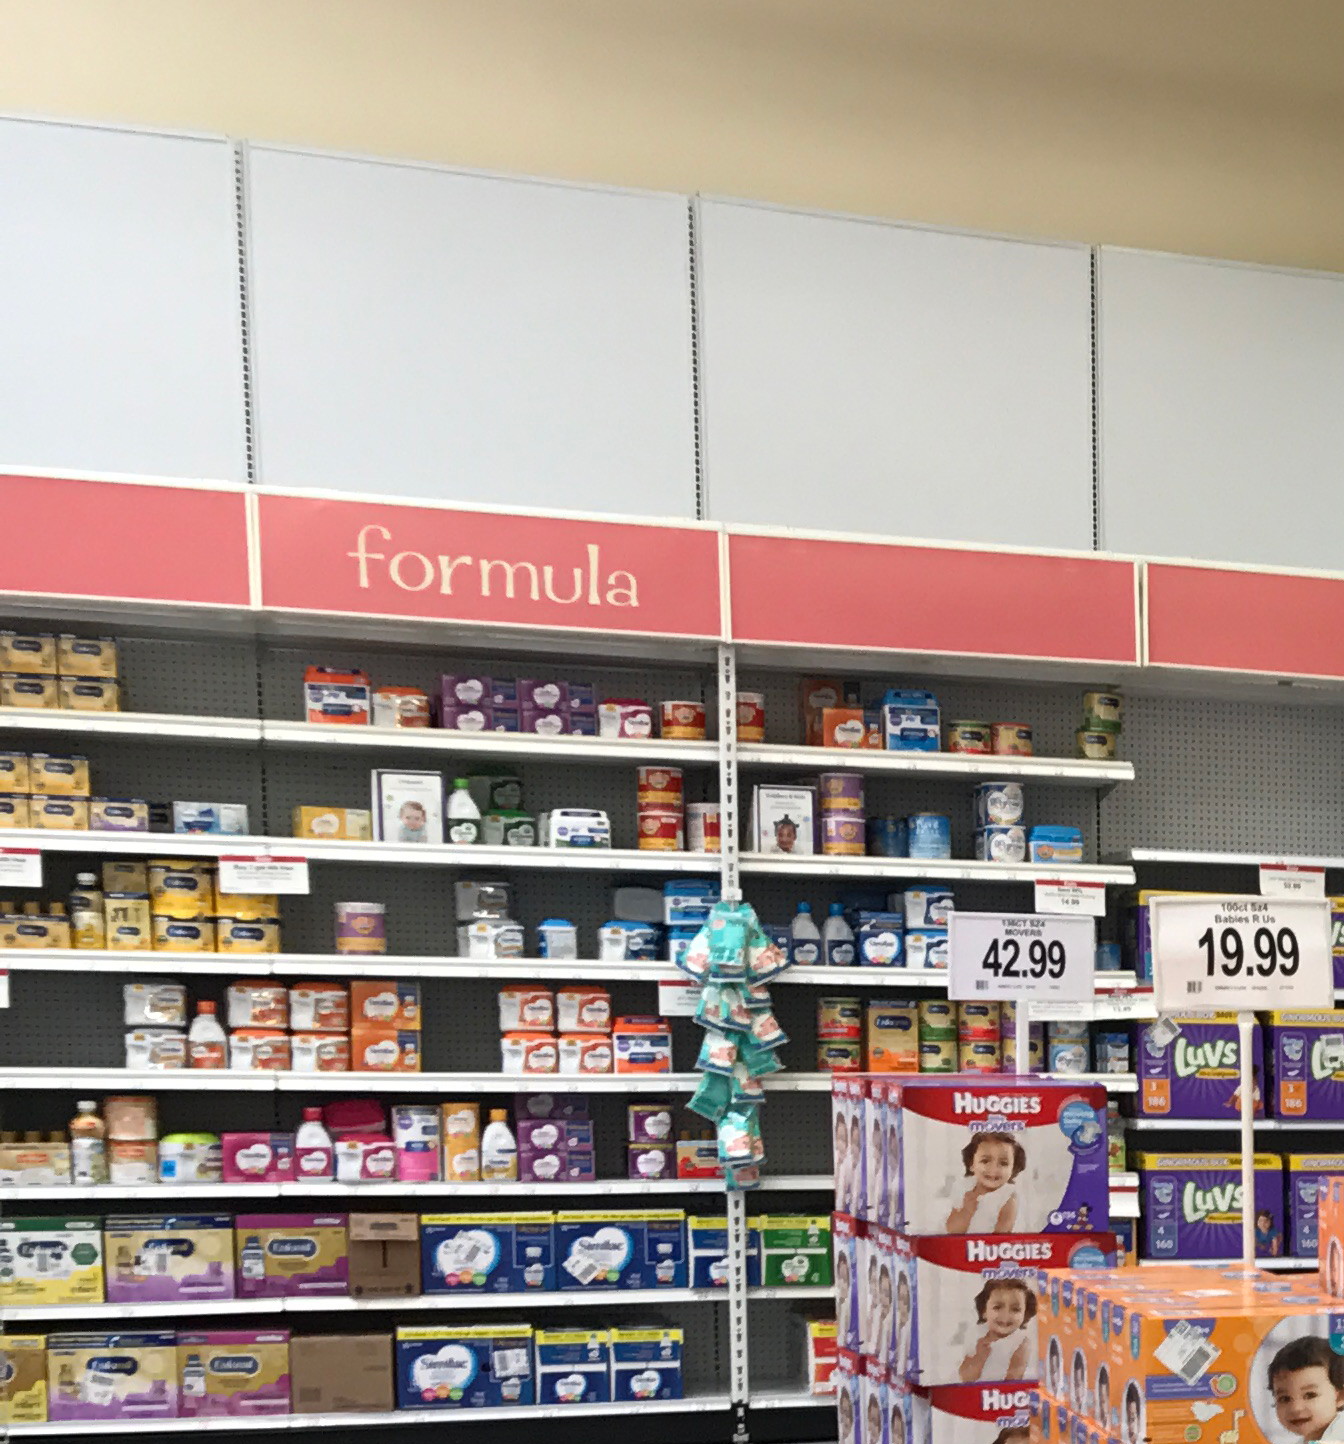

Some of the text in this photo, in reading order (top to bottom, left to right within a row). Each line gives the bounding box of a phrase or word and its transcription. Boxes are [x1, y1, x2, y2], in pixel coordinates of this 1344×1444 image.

[348, 525, 640, 608] formula
[1215, 914, 1275, 924] Babies R Us
[983, 938, 1066, 979] 42.99
[1199, 927, 1300, 977] 19.99
[1174, 1037, 1238, 1078] Luvs
[954, 1092, 1042, 1114] HUGGIES
[1183, 1181, 1244, 1224] Luvs
[966, 1240, 1052, 1262] HUGGIES
